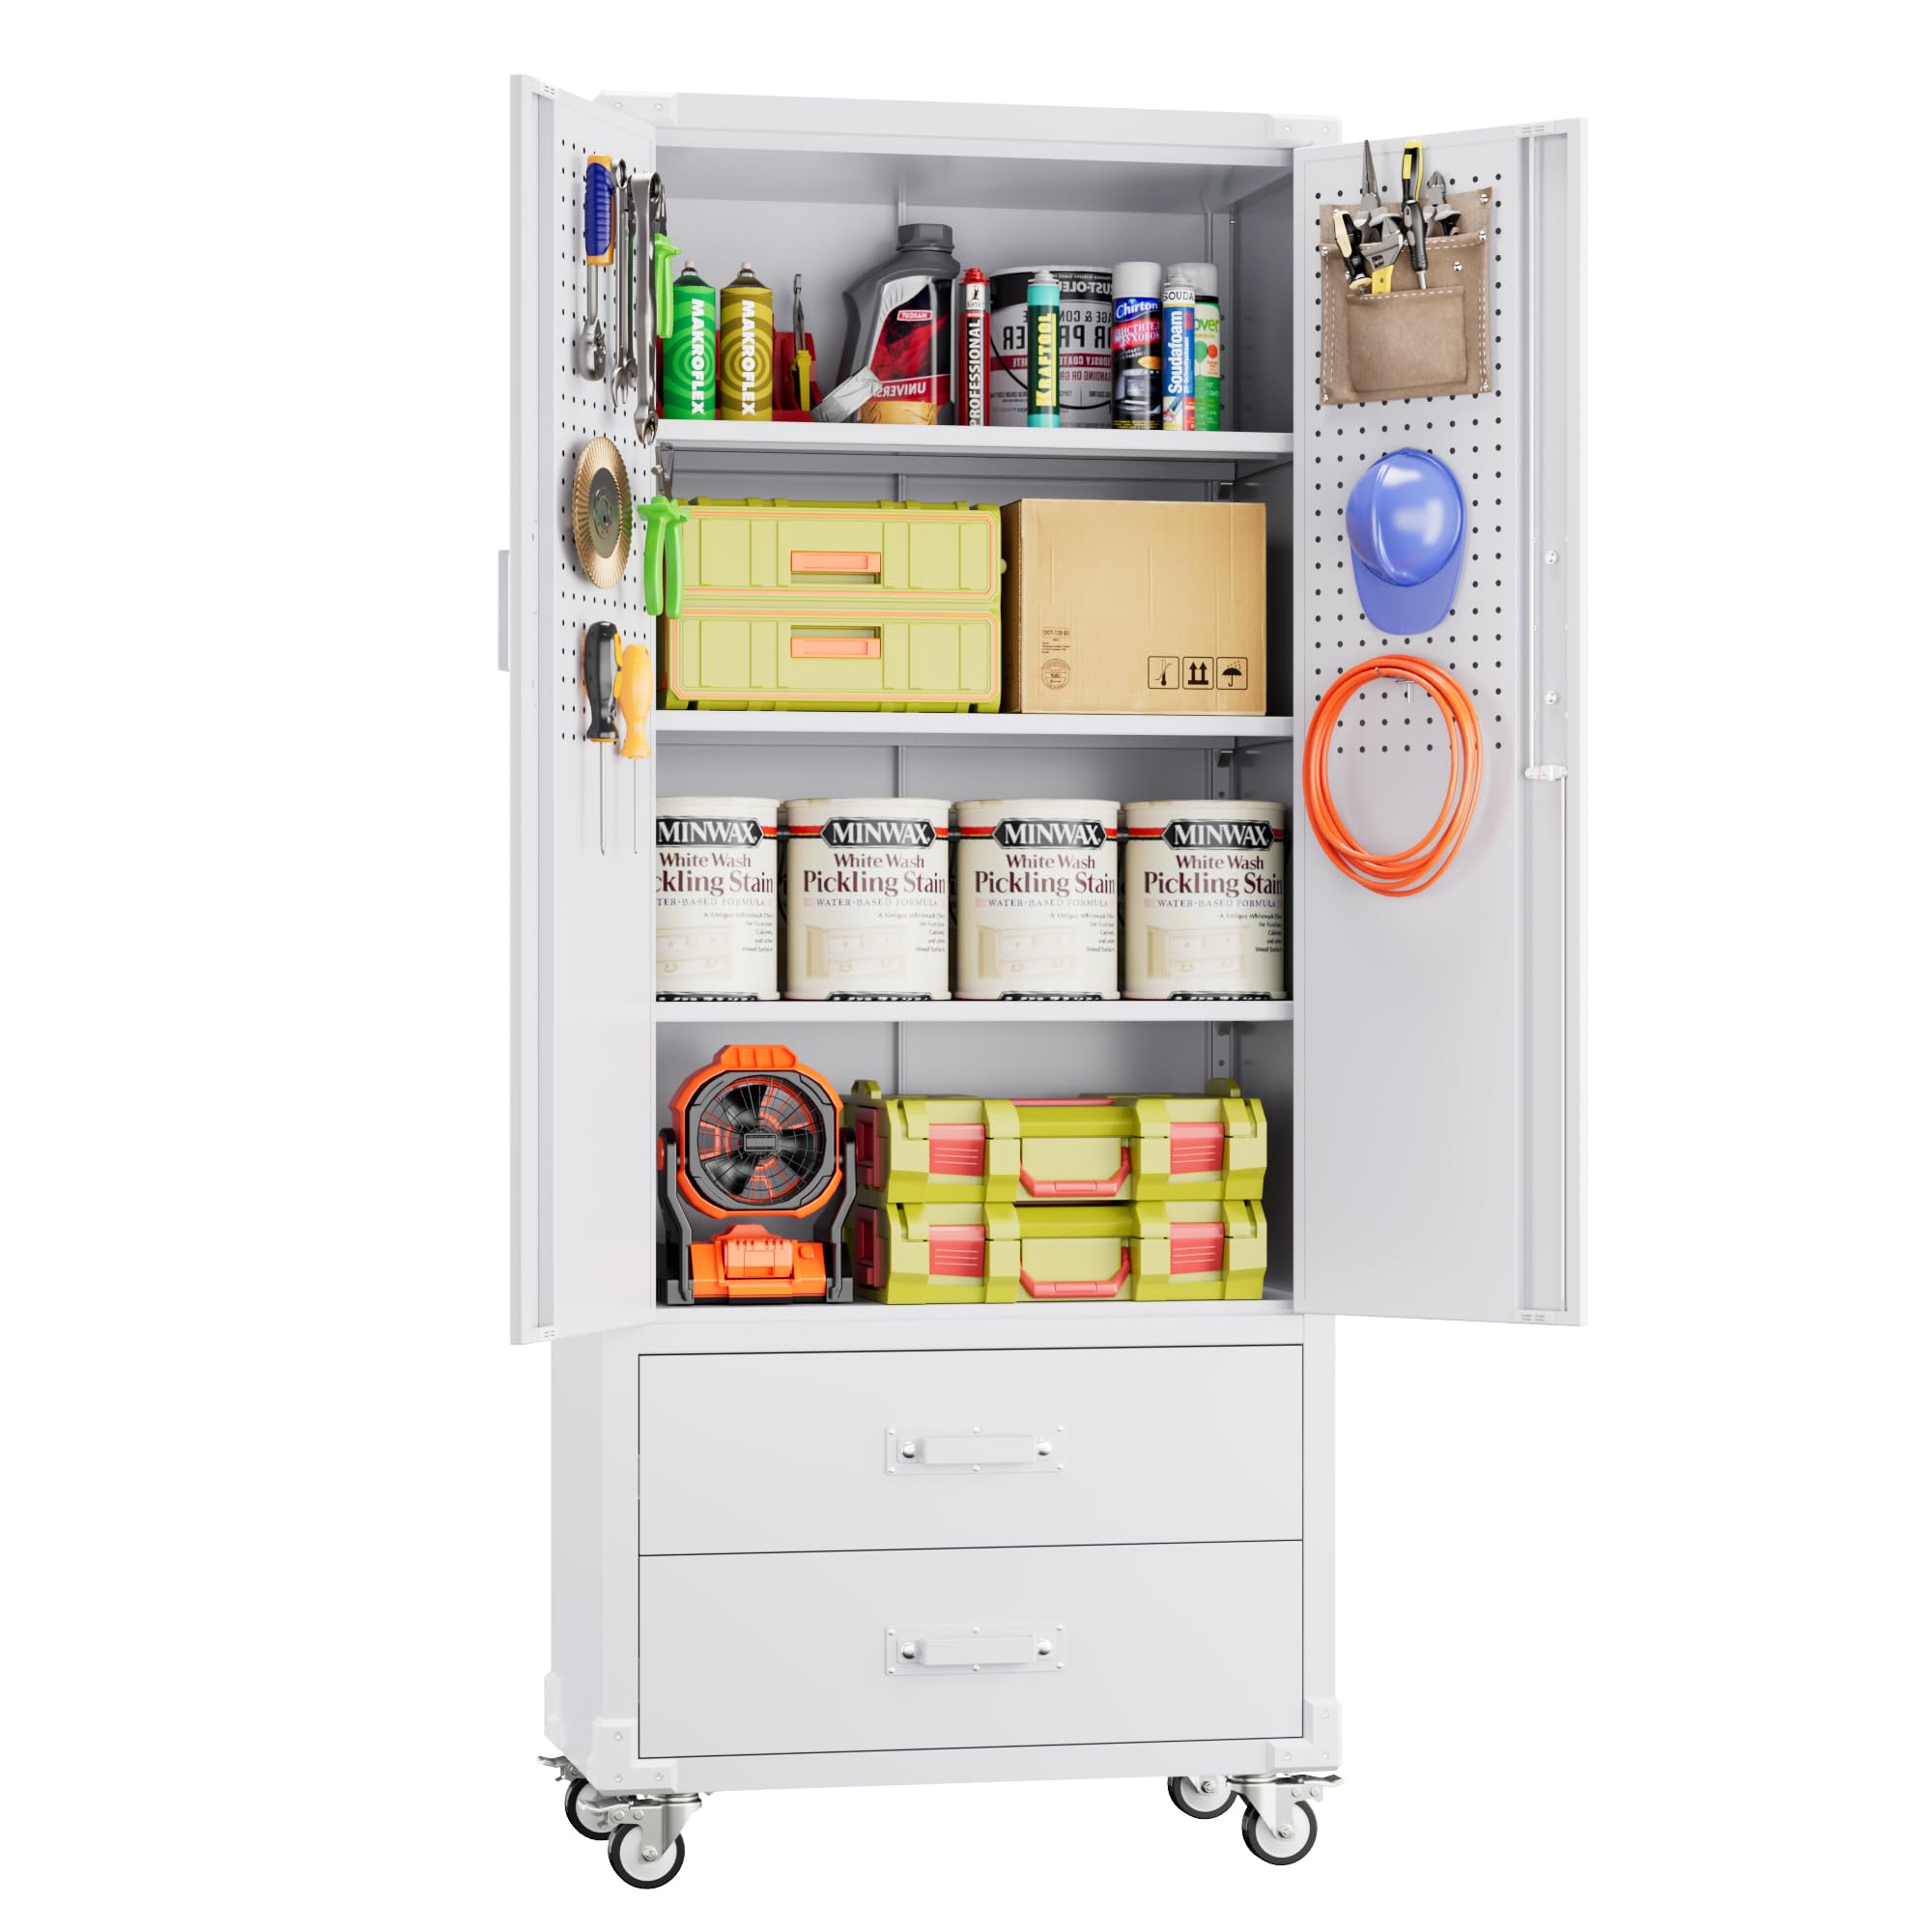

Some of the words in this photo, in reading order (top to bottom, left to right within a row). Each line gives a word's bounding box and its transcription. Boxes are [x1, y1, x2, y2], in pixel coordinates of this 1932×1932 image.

[1116, 300, 1158, 319] Chirton
[691, 298, 705, 415] MAKROFLEX
[741, 299, 756, 416] MAKROFLEX
[1036, 313, 1056, 407] KRAFTOOL
[1168, 311, 1183, 394] Soudafoam
[968, 319, 981, 426] PROFESSIONAL
[658, 821, 755, 843] MINWAX
[833, 822, 928, 844] MINWAX
[1005, 823, 1099, 845] MINWAX
[1174, 824, 1267, 846] MINWAX
[660, 852, 708, 867] White
[712, 852, 752, 867] Wash
[834, 853, 883, 867] White
[886, 853, 924, 868] Wash
[1006, 854, 1055, 868] White
[1058, 854, 1095, 868] Wash
[1176, 855, 1224, 869] White
[1227, 855, 1264, 869] Wash
[656, 870, 724, 896] ckling
[729, 870, 773, 894] Stain
[804, 870, 898, 896] Pickling
[904, 871, 945, 894] Stain
[975, 870, 1070, 897] Pickling
[1075, 871, 1115, 895] Stain
[1144, 871, 1239, 898] Pickling
[1244, 872, 1283, 895] Stain
